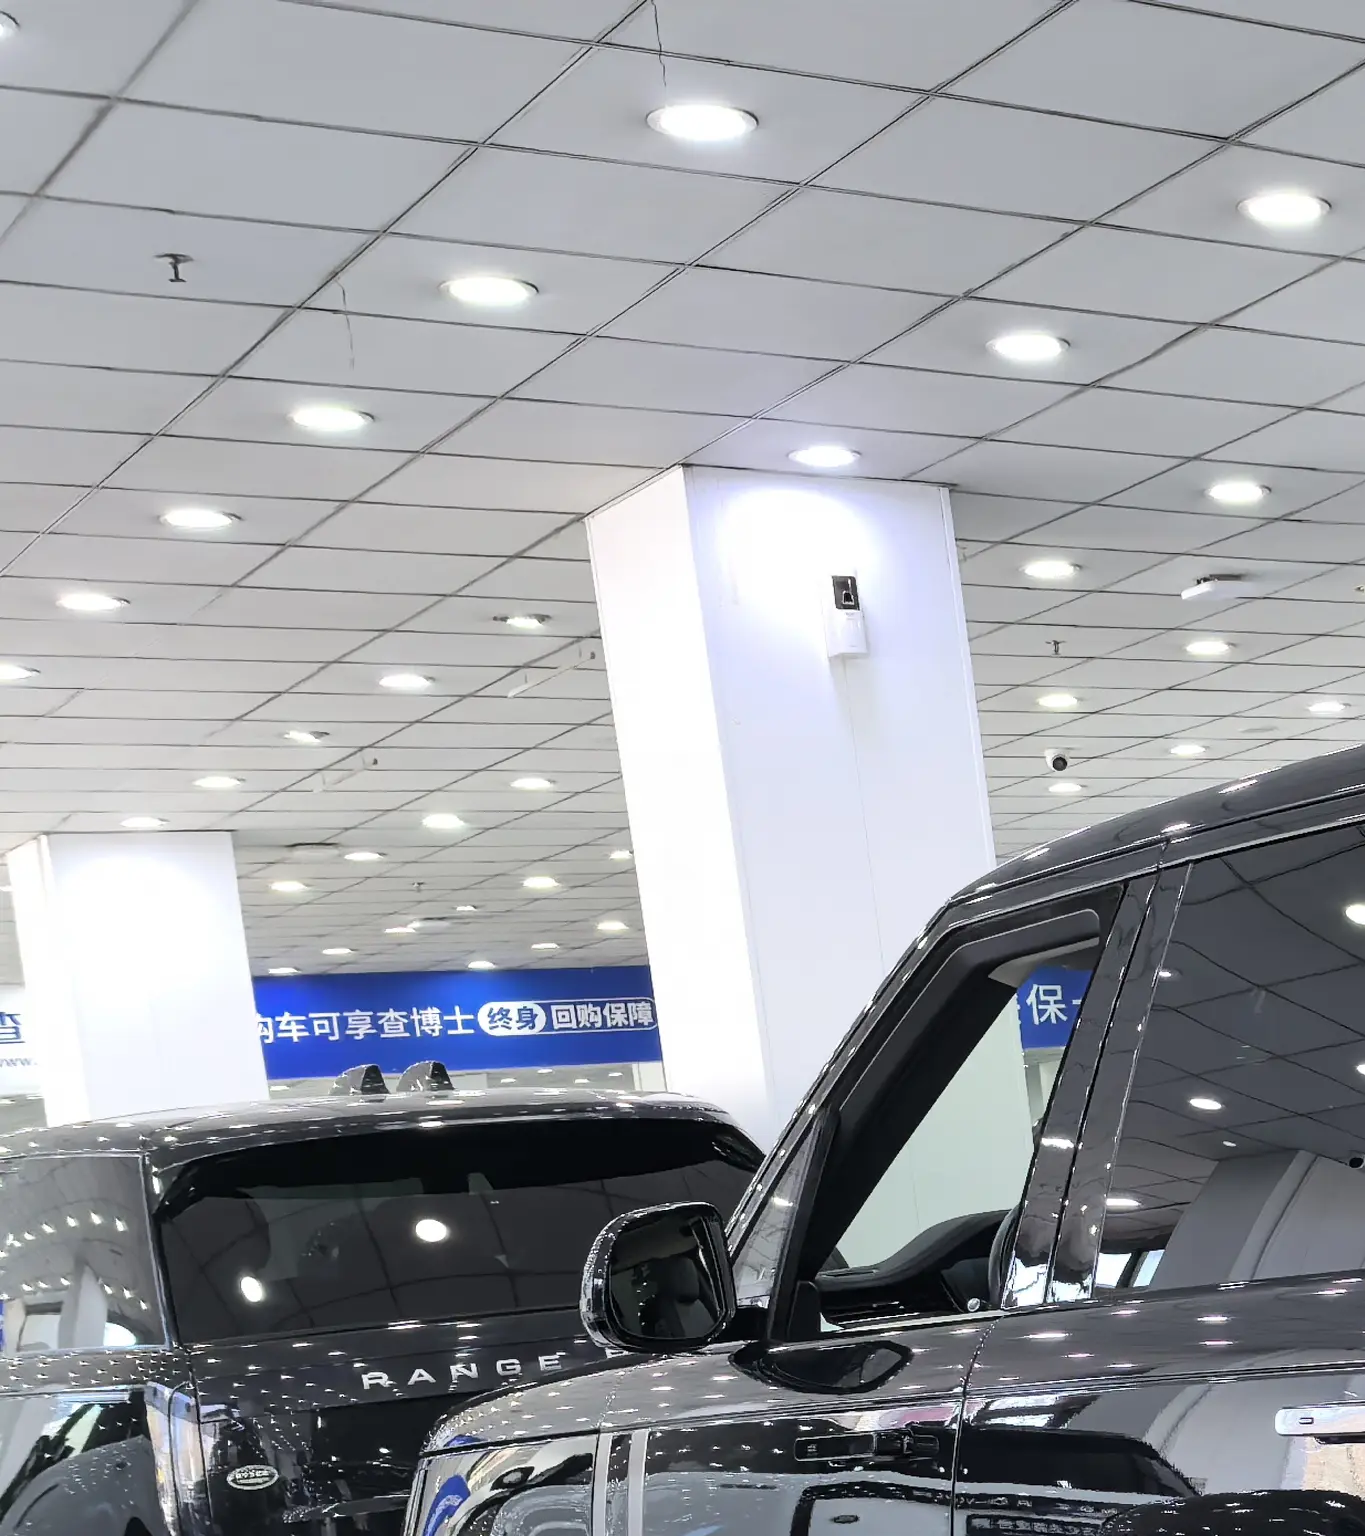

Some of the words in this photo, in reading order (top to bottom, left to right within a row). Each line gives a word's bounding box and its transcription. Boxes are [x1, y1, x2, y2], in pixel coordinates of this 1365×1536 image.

[552, 1001, 655, 1030] 回购保障
[1026, 983, 1083, 1026] 保
[361, 1353, 563, 1390] RANGE
